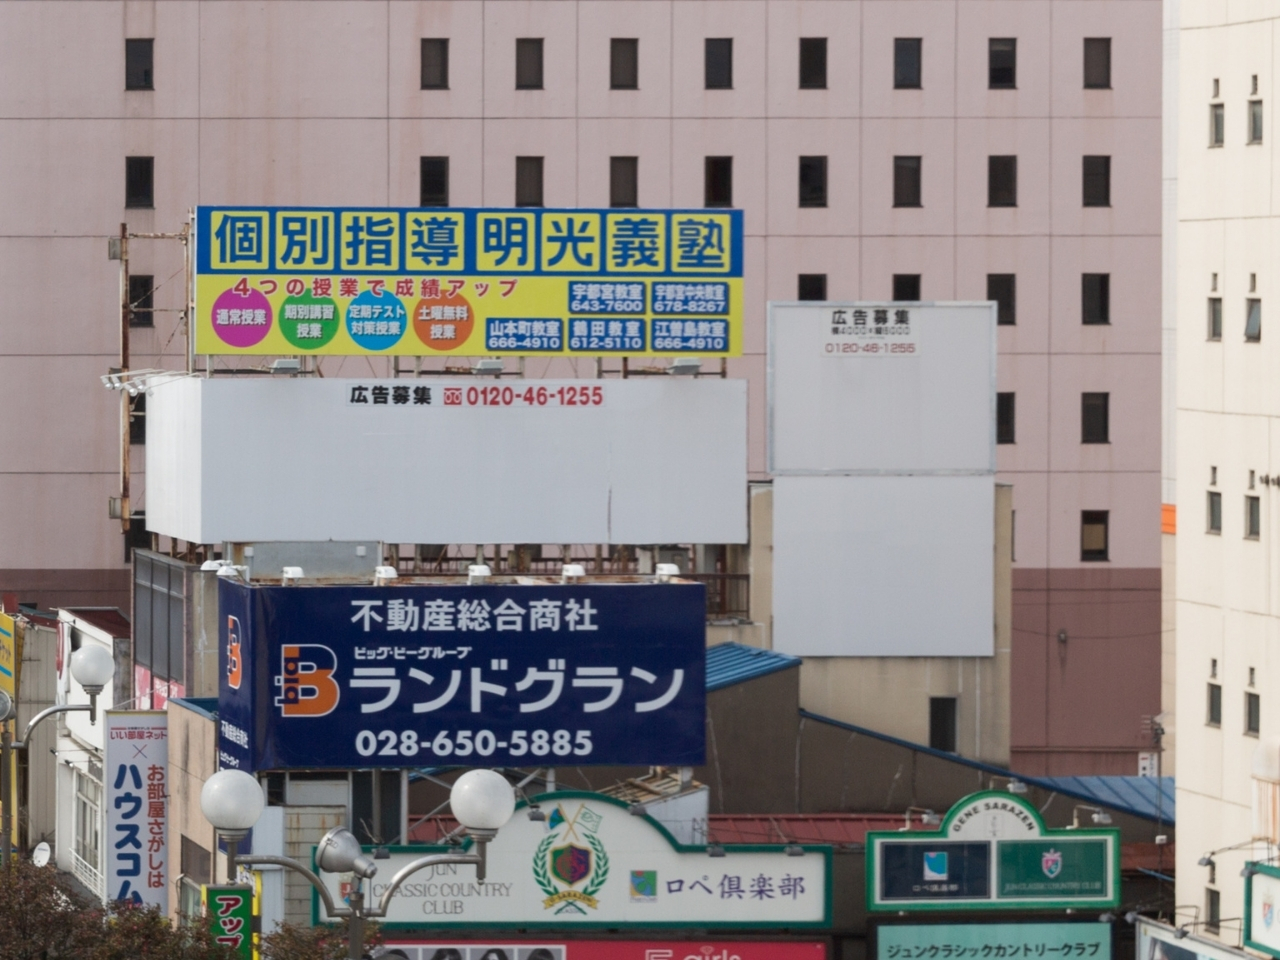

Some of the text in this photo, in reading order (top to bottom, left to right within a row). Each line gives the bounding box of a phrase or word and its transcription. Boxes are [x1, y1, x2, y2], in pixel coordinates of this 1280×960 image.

[232, 276, 519, 299] 4つの授業で成績アップ
[572, 283, 644, 300] 宇都宮教室
[284, 304, 335, 320] 期別講習
[348, 303, 405, 319] 定期テスト
[418, 305, 469, 321] 土曜無料
[570, 300, 643, 312] 643-7600
[653, 300, 726, 312] 678-8267
[216, 308, 267, 326] 通常授業
[831, 309, 910, 326] 広告募集
[296, 322, 323, 339] 授業
[351, 320, 402, 336] 対策授業
[430, 324, 456, 340] 授業
[489, 320, 561, 337] 山本町教室
[488, 337, 560, 349] 666-4910
[570, 337, 643, 349] 612-5110
[653, 337, 725, 350] 666-4910
[349, 386, 604, 406] 広告募集 0120-46-1255
[350, 599, 599, 632] 不動産総合商社
[349, 664, 685, 714] ランドグラン
[355, 730, 593, 757] 028-650-5885
[146, 763, 166, 889] お部屋さがしは
[952, 802, 1036, 833] GENE SARAZEN
[439, 882, 514, 898] COUNTRY
[666, 874, 806, 901] ロペ倶楽部
[422, 901, 464, 915] CLUB
